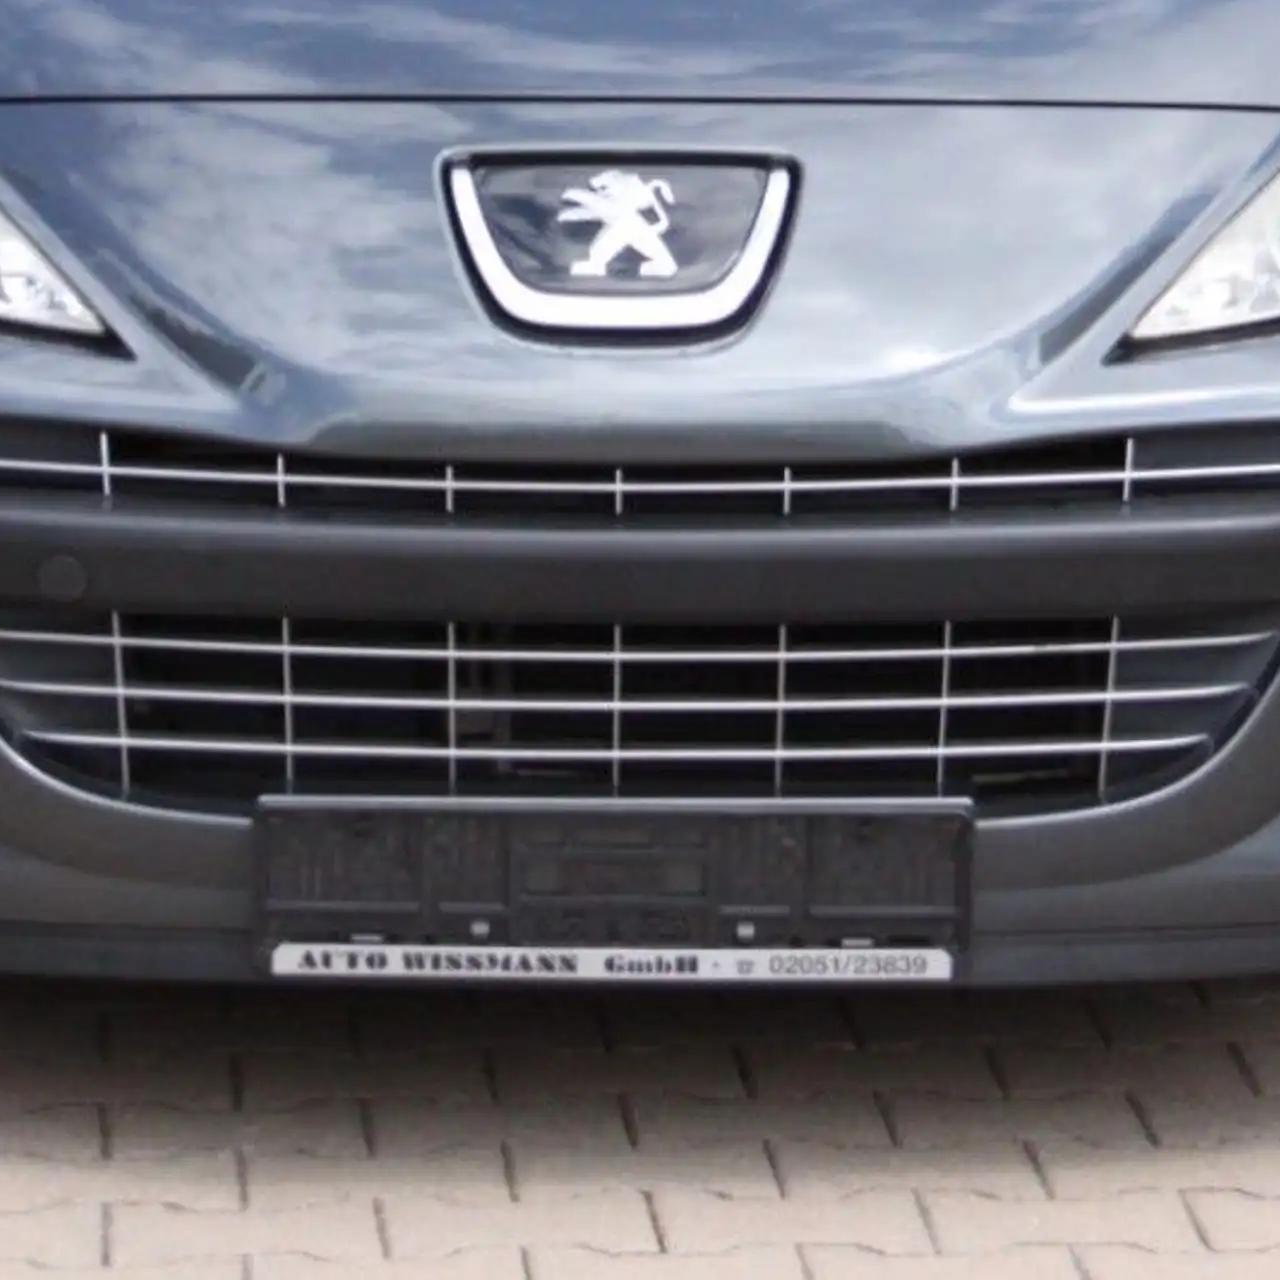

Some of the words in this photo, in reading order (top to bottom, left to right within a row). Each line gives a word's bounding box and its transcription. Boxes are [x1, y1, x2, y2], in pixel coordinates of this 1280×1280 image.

[298, 949, 388, 971] AUTO
[401, 951, 579, 974] WISSMANN
[603, 954, 699, 976] GmbH
